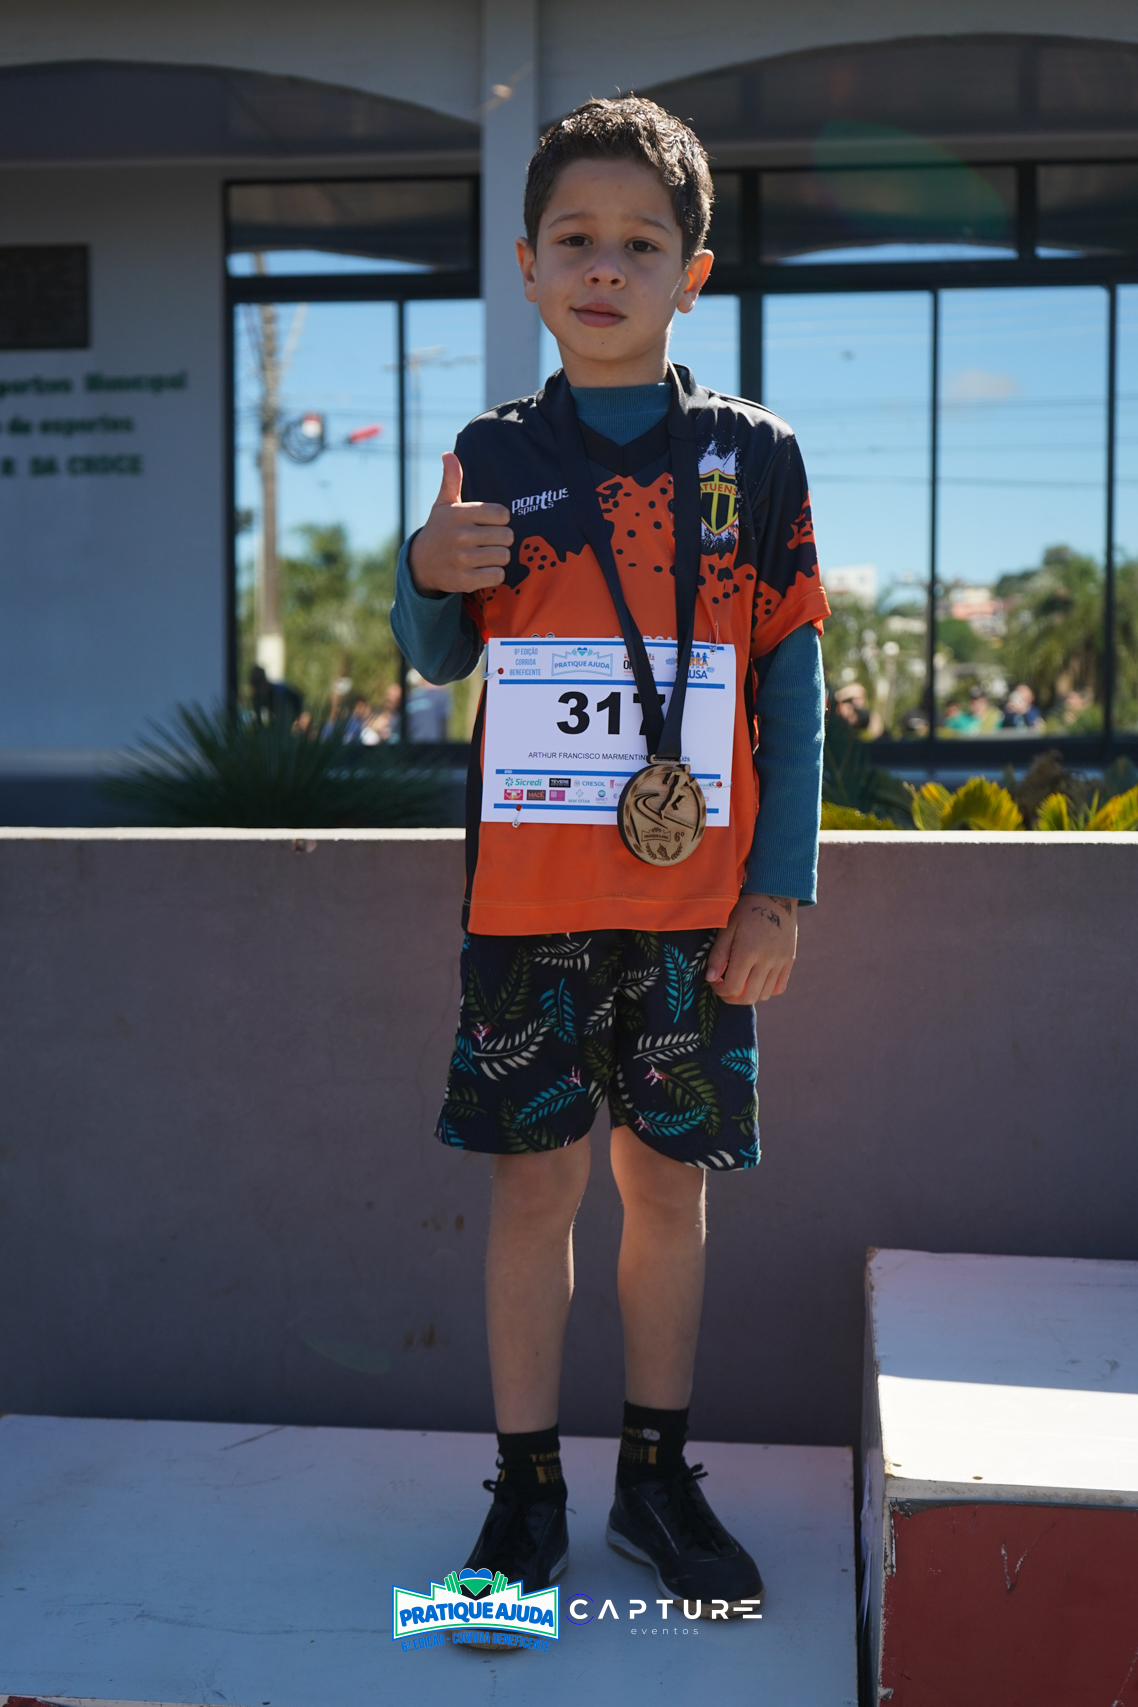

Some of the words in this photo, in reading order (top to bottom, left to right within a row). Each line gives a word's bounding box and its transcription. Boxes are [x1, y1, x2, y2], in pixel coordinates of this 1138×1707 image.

[520, 647, 538, 656] EDIÇÃO
[554, 660, 587, 669] PRATIQUE
[589, 661, 610, 669] AJUDA
[558, 752, 600, 760] FRANCISCO
[602, 753, 648, 761] MARMENTIN
[515, 778, 542, 786] Sicredi
